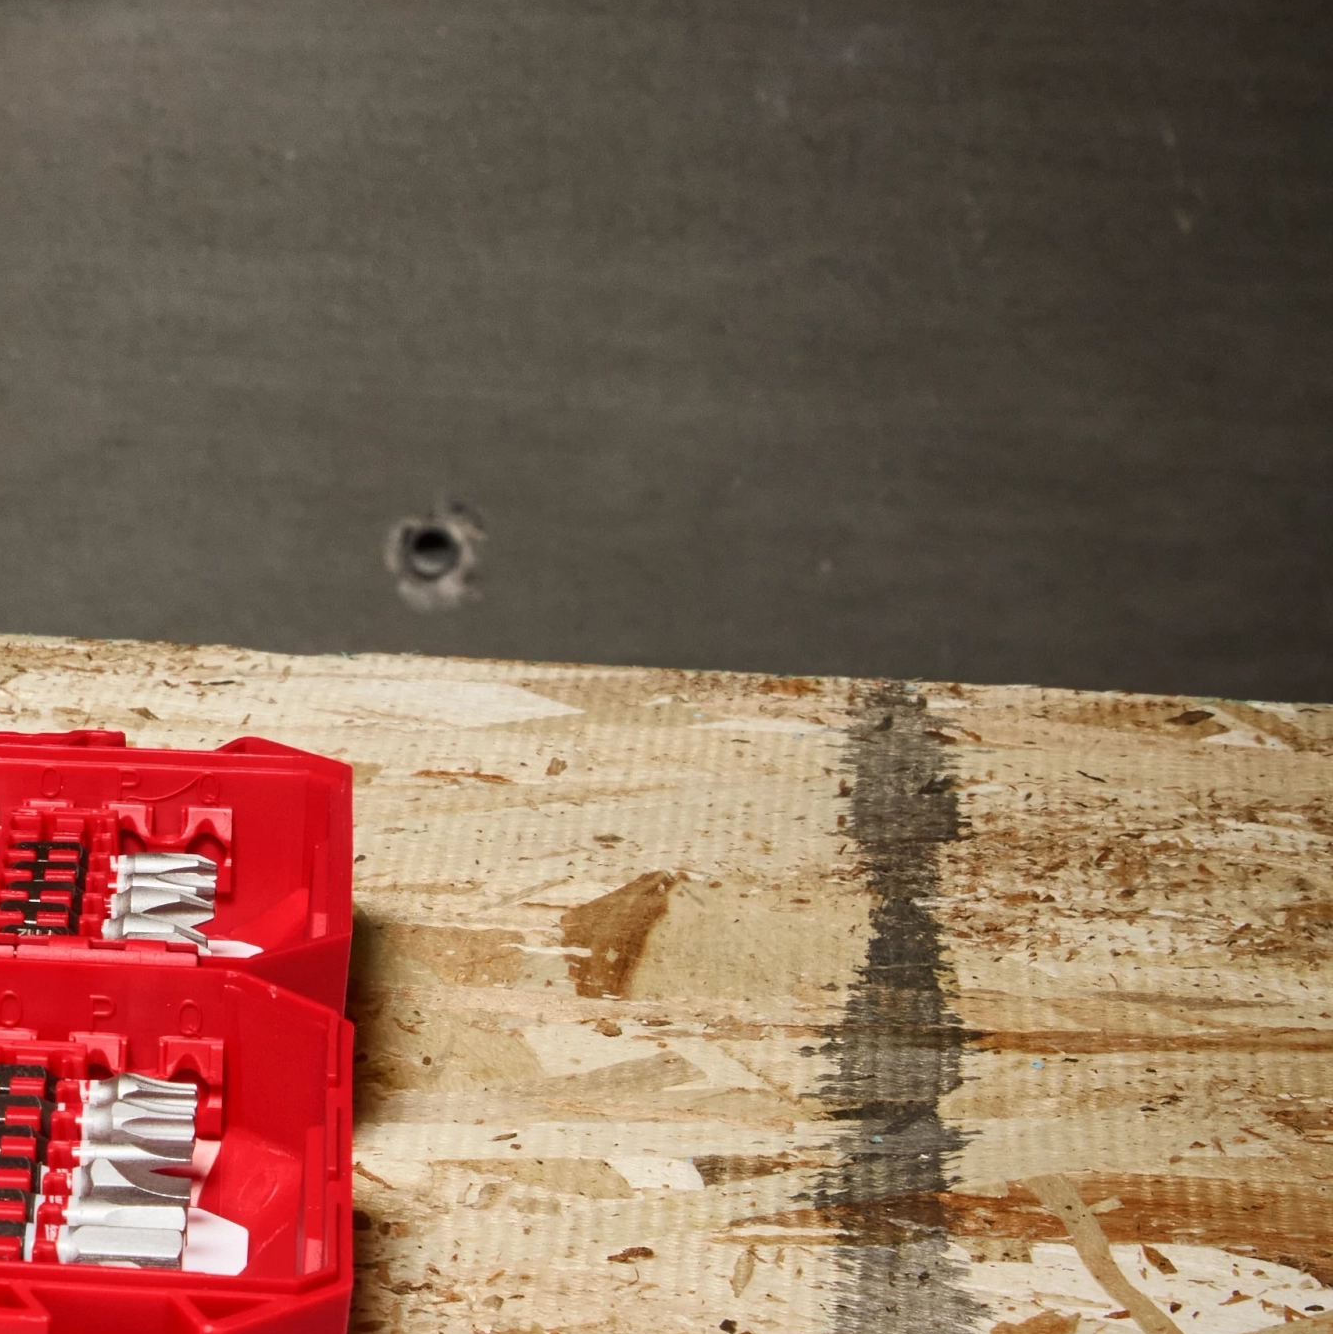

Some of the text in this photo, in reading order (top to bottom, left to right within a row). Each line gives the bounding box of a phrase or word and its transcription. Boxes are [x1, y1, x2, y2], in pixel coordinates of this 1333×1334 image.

[118, 768, 142, 802] P
[89, 994, 117, 1032] P
[178, 998, 203, 1039] Q
